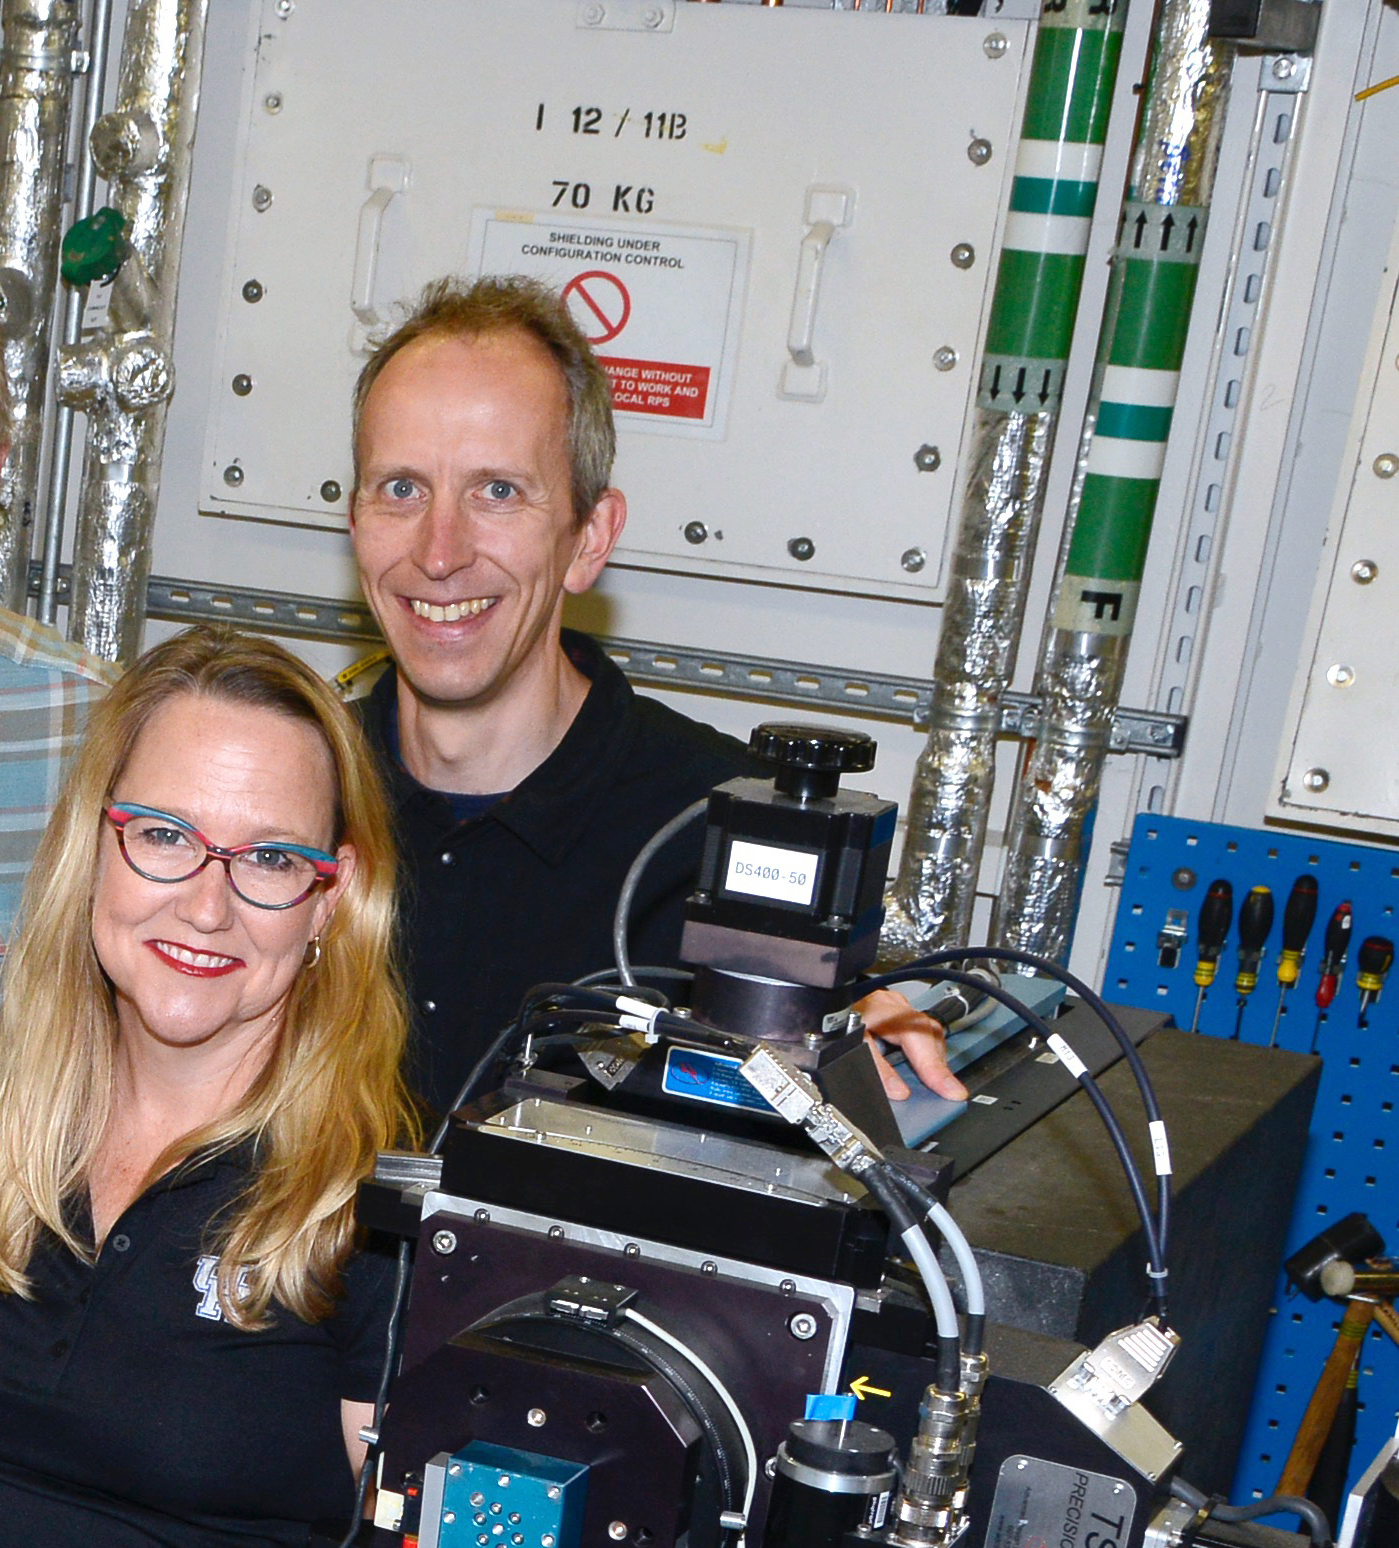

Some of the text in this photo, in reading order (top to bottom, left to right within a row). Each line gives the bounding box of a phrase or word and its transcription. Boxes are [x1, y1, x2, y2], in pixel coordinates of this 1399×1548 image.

[572, 106, 602, 134] 12
[644, 112, 687, 140] 11B
[551, 181, 655, 214] 70 KG
[549, 232, 660, 251] SHIELDING UNDER
[521, 244, 685, 268] CONFIGURATION CONTROL
[641, 369, 692, 383] WITHOUT
[614, 392, 670, 407] OCAL RPS
[620, 381, 635, 390] TO
[637, 382, 672, 395] WORK
[674, 386, 699, 398] AND
[735, 862, 807, 886] DS400-50
